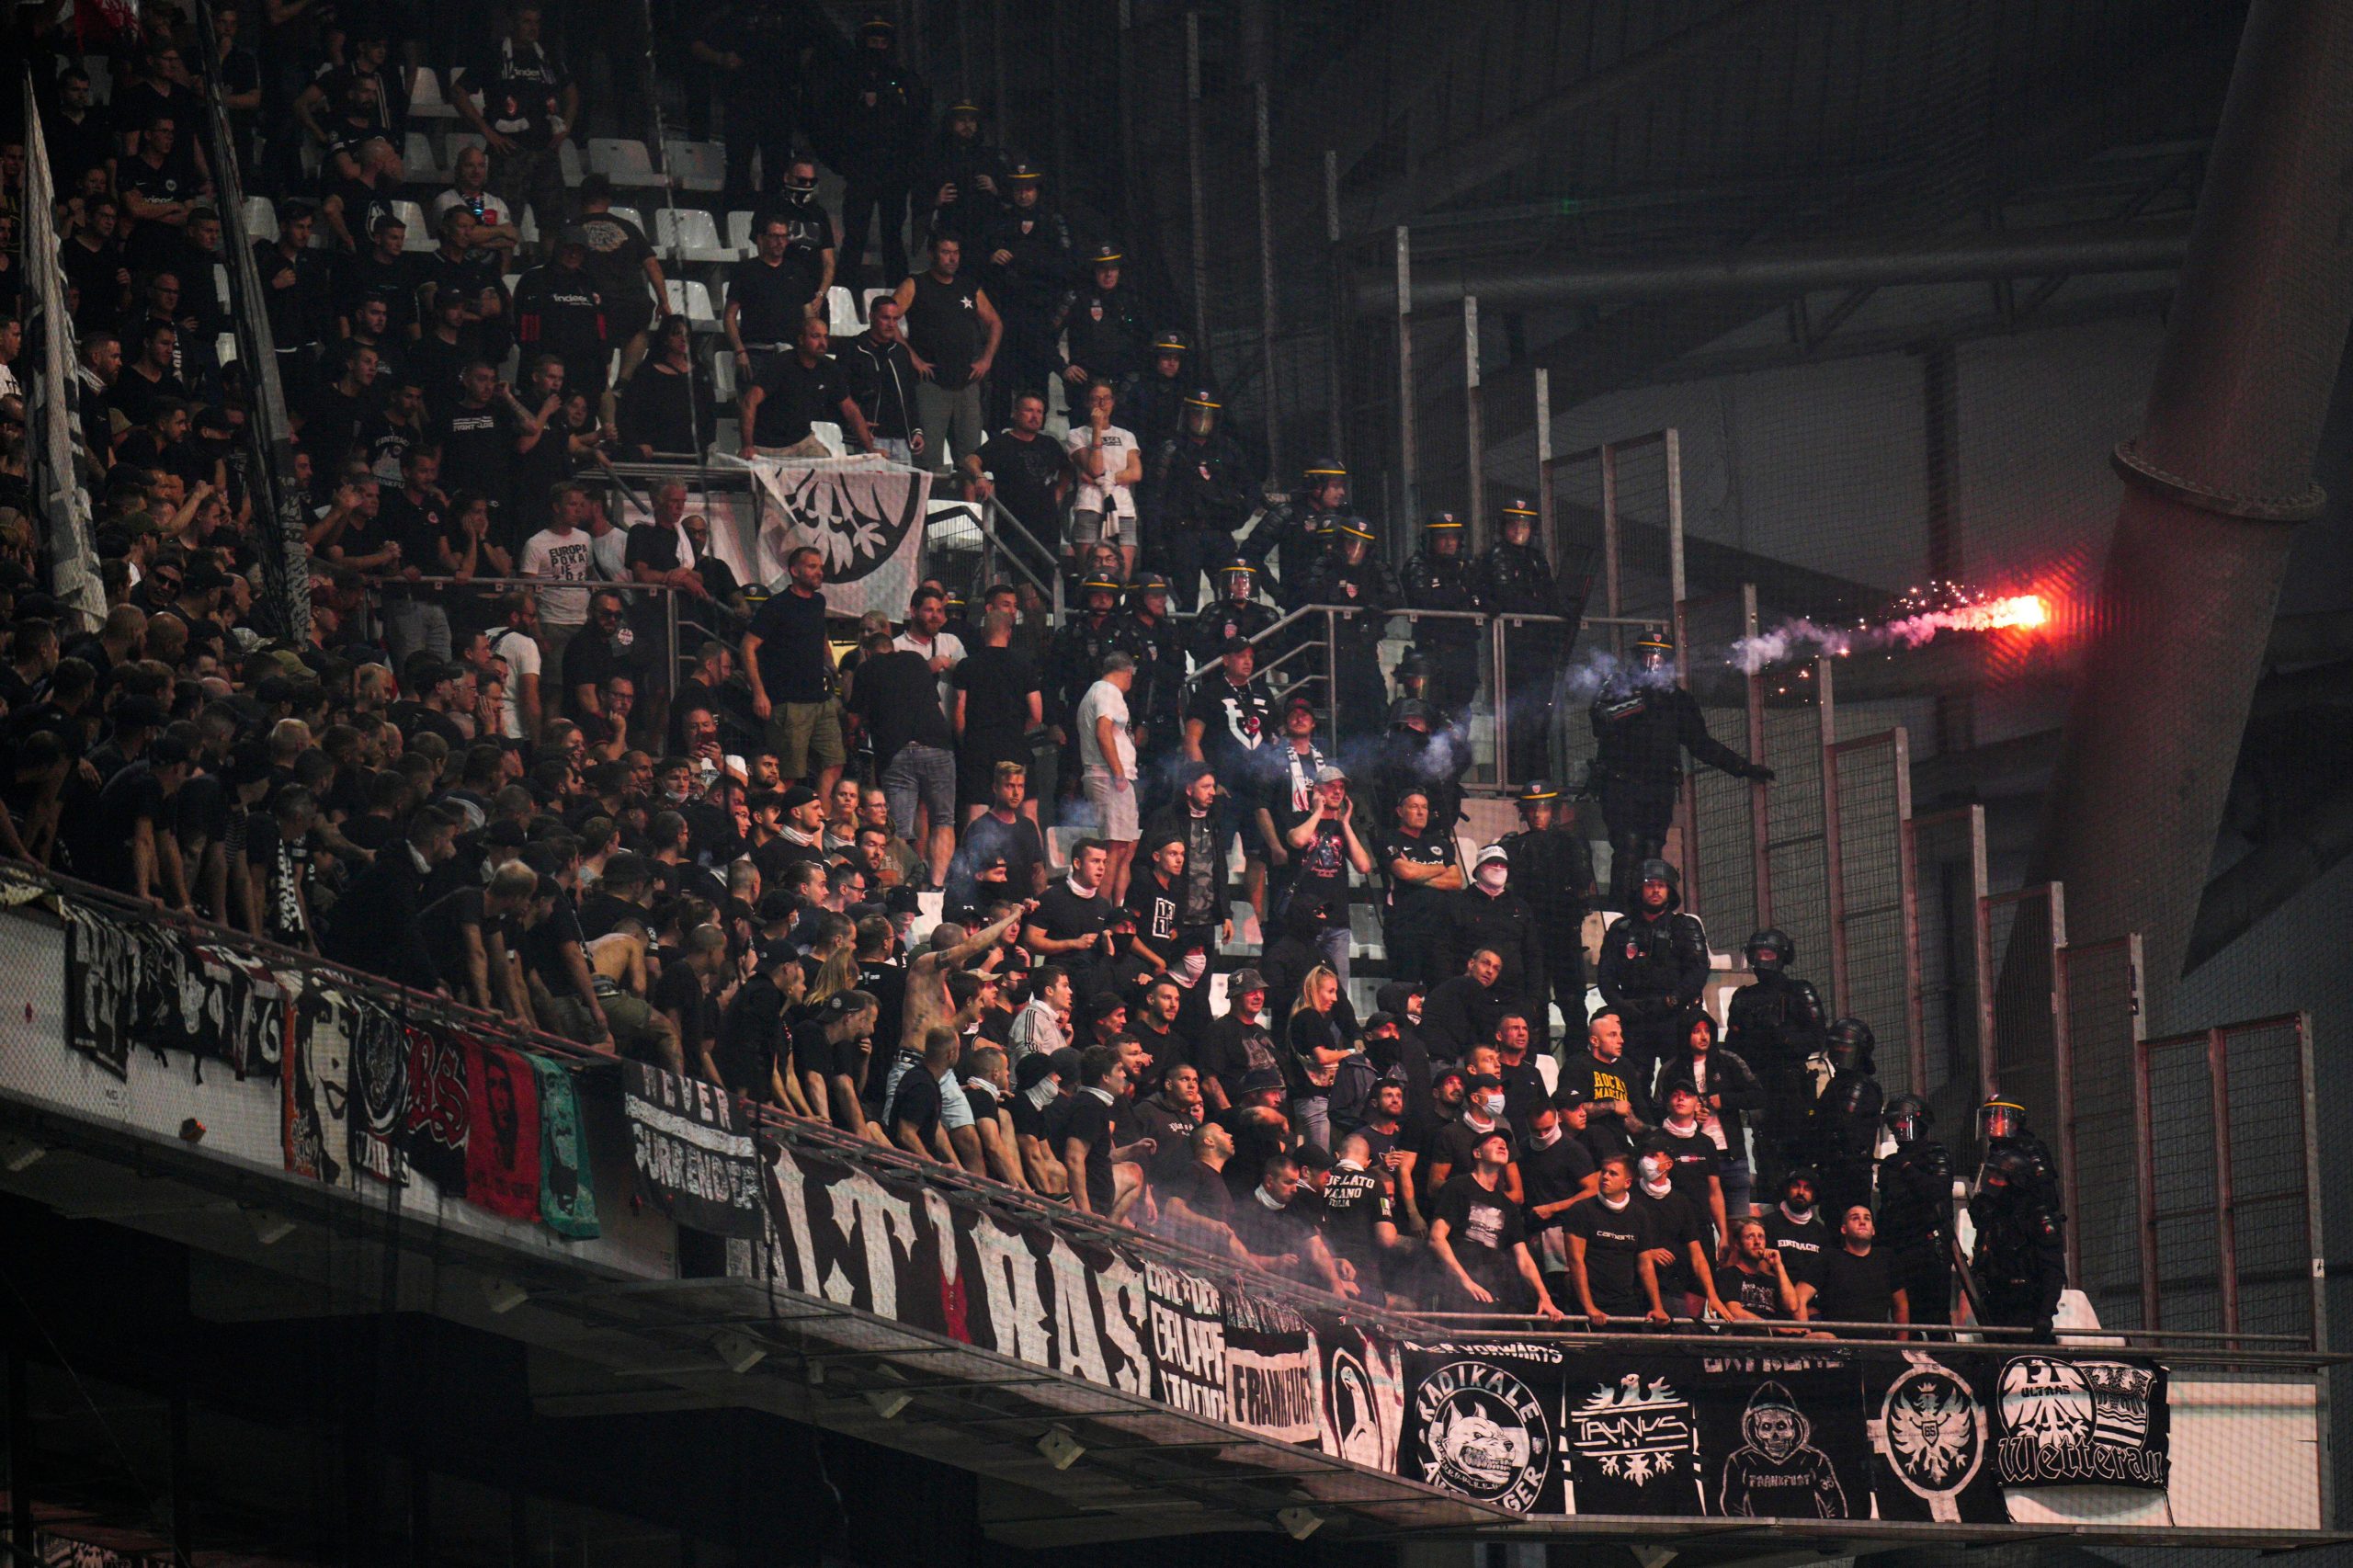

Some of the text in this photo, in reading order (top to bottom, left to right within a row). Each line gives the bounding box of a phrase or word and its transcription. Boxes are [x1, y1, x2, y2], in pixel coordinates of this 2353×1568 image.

[549, 544, 588, 559] EUROPA
[642, 1064, 733, 1131] NEVER
[631, 1122, 761, 1210] SURRENDER
[749, 1142, 1153, 1399] LTRAS
[1777, 1239, 1822, 1254] EINTRACHT
[1149, 1300, 1226, 1386] GRUPPE
[1419, 1364, 1540, 1424] RADIKALE
[2020, 1385, 2072, 1398] ULTRAS
[1571, 1415, 1689, 1445] TAUNUS
[1748, 1474, 1812, 1488] FRANKFURT
[1997, 1435, 2165, 1484] Wetterau
